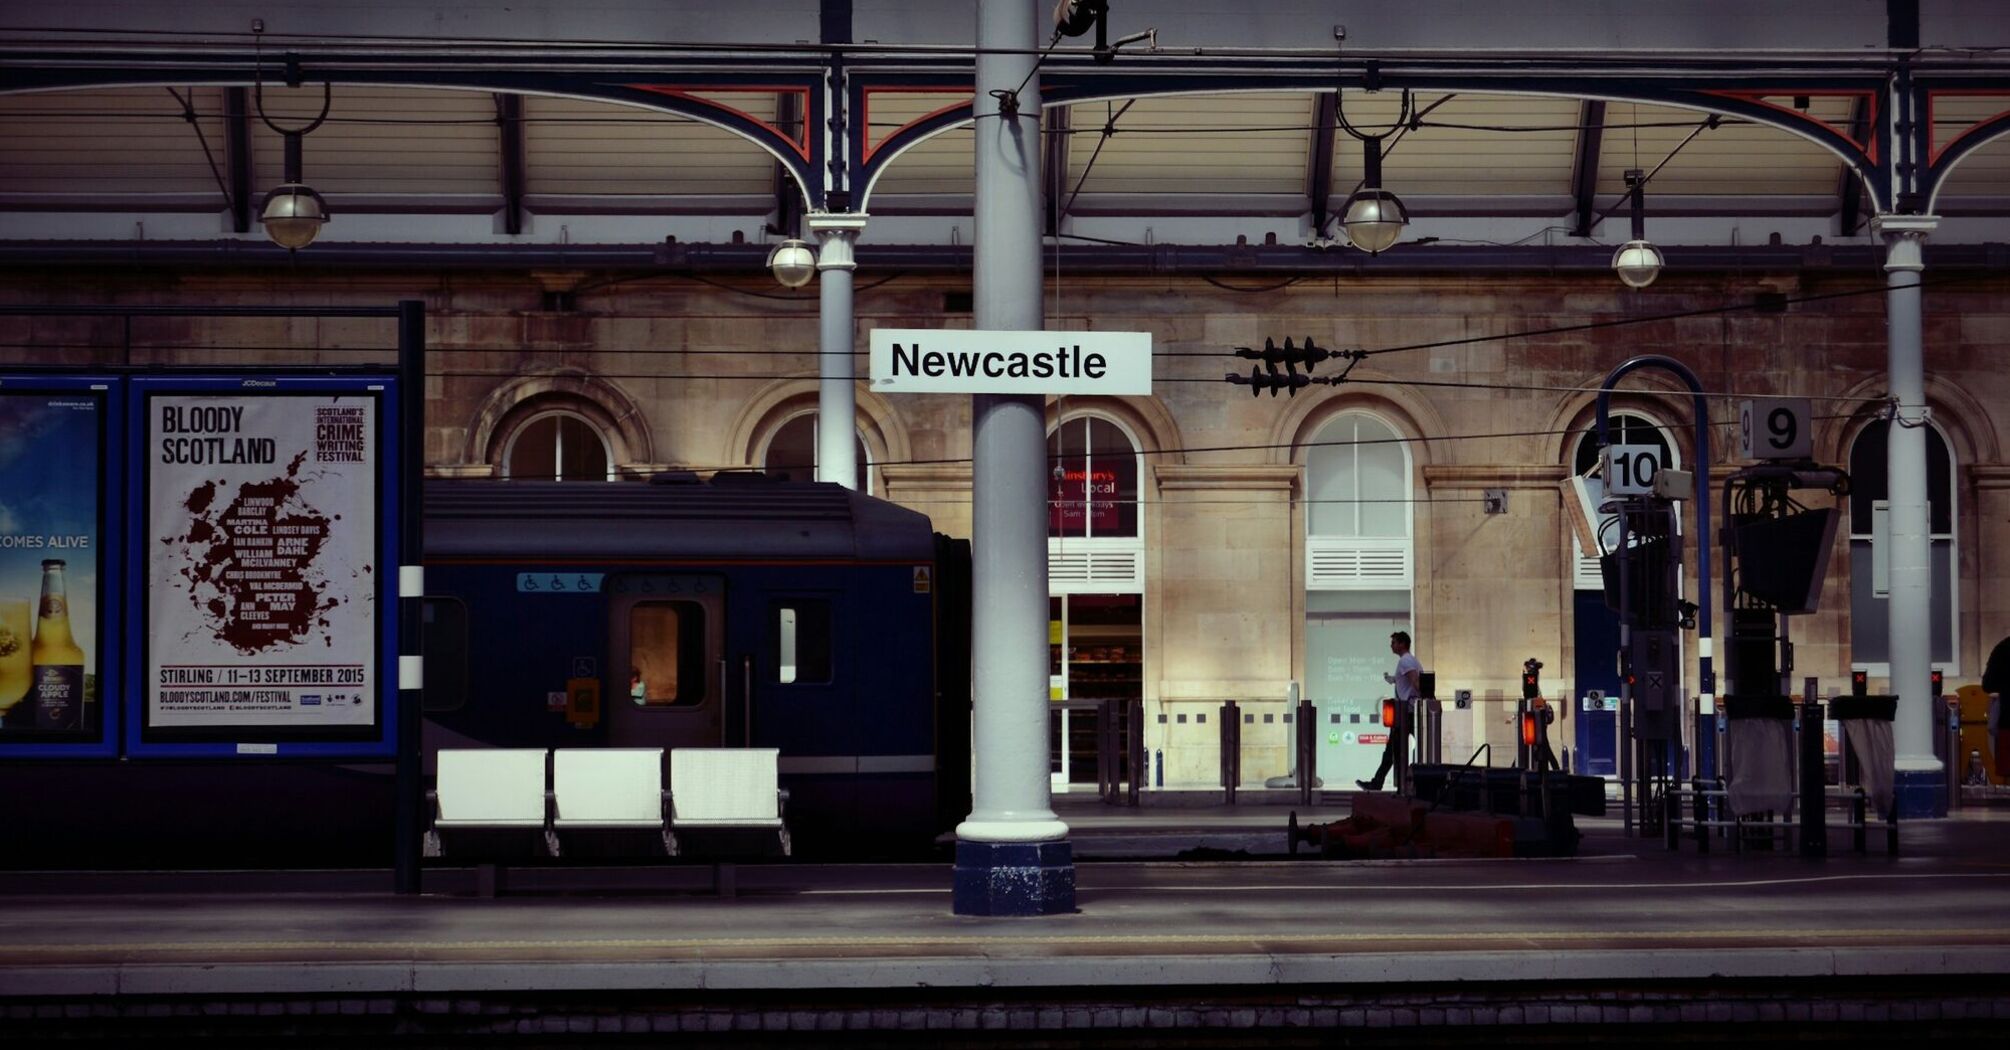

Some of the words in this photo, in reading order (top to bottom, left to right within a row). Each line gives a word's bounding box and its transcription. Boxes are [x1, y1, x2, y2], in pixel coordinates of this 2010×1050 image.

[892, 343, 1106, 378] Newcastle
[316, 408, 364, 416] SCOTLAND'S
[162, 406, 244, 433] BLOODY
[316, 416, 364, 424] INTERNATIONAL
[316, 424, 364, 440] CRIME
[1768, 407, 1797, 450] 9
[316, 440, 364, 451] WRITING
[162, 437, 276, 464] SCOTLAND
[316, 451, 364, 462] FESTIVAL
[1614, 452, 1659, 488] 10
[1081, 482, 1115, 494] Local
[244, 498, 274, 507] LINWOOD
[238, 507, 267, 516] BARCLAY
[233, 526, 268, 535] COLE
[272, 526, 299, 535] LINDSEY
[300, 526, 320, 535] DAVIS
[47, 535, 88, 548] ALIVE
[233, 538, 246, 546] IAN
[247, 538, 273, 546] RANKIN
[277, 537, 309, 547] ARNE
[234, 550, 273, 559] WILLIAM
[277, 546, 308, 556] DAHL
[241, 558, 298, 567] MCILVANNEY
[255, 593, 296, 602] PETER
[240, 602, 256, 611] ANN
[270, 602, 296, 611] MAY
[240, 611, 270, 620] CLEEVES
[160, 669, 212, 684] STIRLING
[265, 668, 333, 683] SEPTEMBER
[337, 668, 365, 683] 2015
[40, 690, 69, 698] APPLE
[160, 690, 291, 703] BLOODYSCOTLAND.COM/FESTIVAL
